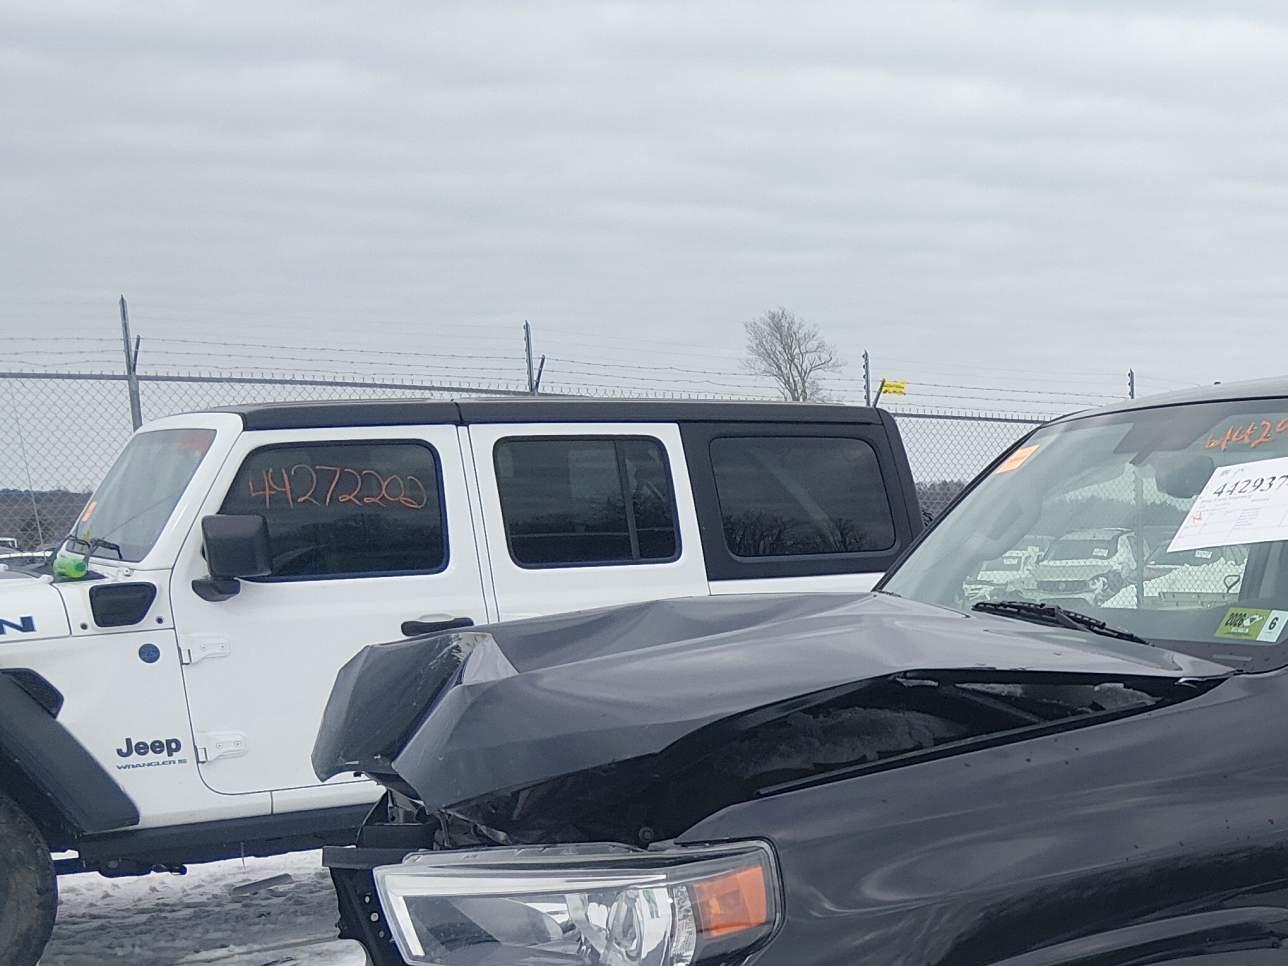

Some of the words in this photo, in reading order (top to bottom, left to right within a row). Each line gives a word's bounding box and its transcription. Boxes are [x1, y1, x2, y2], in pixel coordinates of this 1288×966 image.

[1268, 616, 1279, 631] 6
[116, 737, 182, 758] Jeep
[116, 759, 176, 770] WRANGLER
